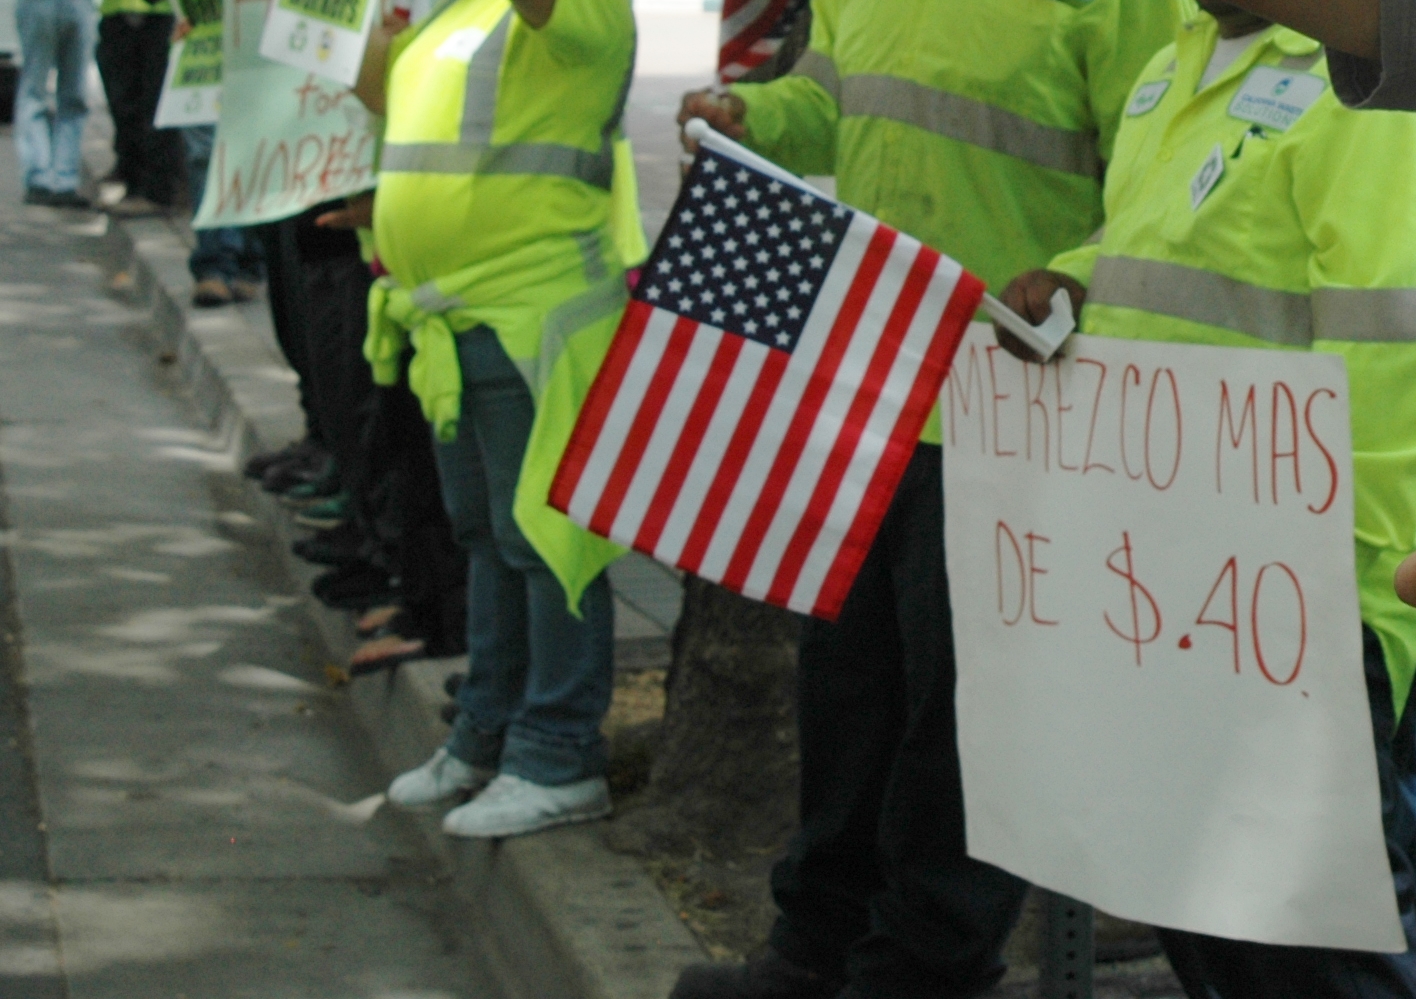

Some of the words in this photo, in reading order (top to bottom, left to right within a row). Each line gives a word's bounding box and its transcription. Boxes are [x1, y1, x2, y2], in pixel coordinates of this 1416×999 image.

[947, 342, 1183, 491] MEREZCO
[1216, 378, 1339, 515] MAS
[996, 519, 1060, 627] DE
